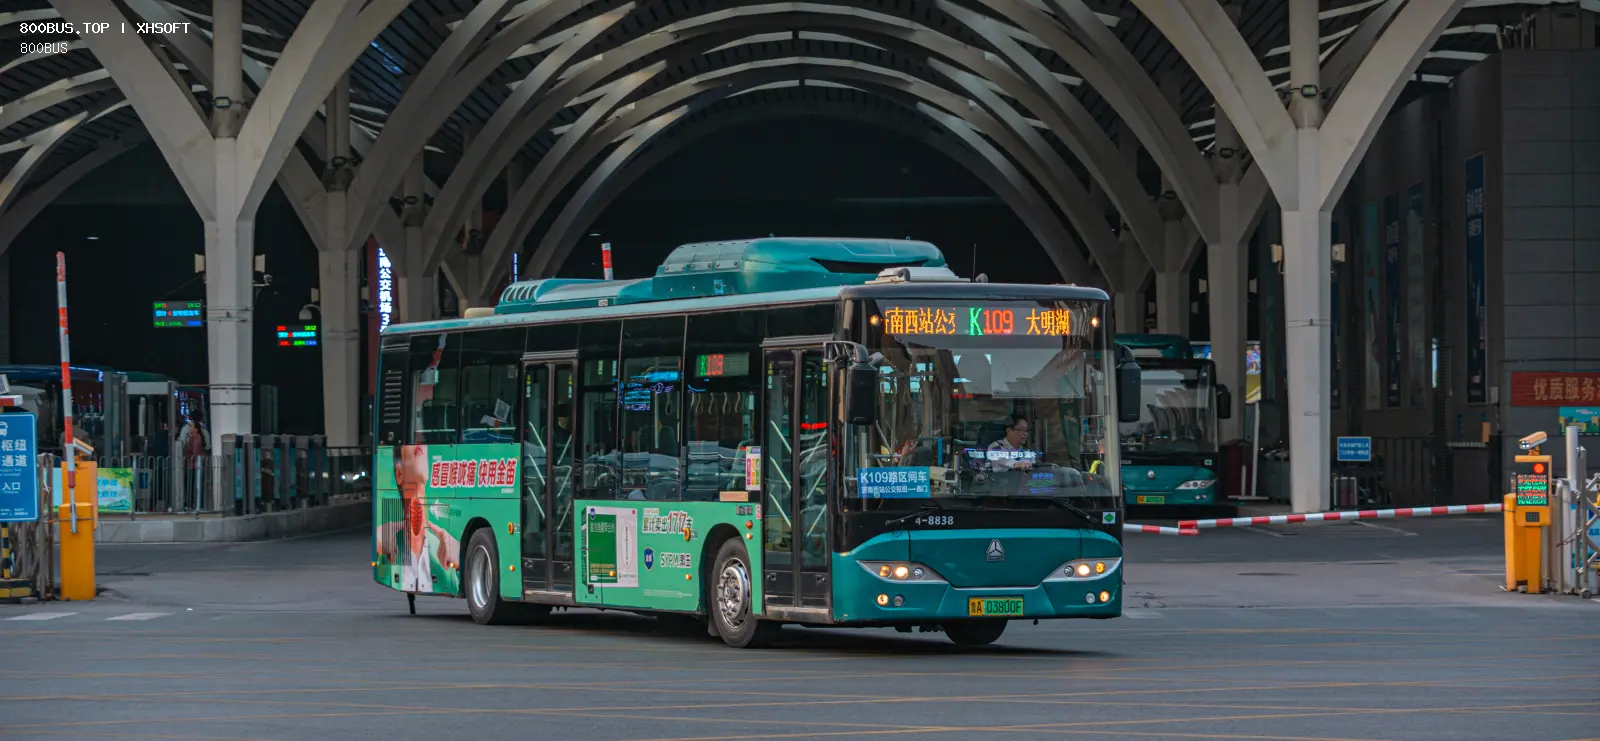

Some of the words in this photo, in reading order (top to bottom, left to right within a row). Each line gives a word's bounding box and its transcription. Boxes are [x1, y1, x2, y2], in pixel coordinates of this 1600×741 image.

[969, 307, 1015, 336] K109
[1025, 308, 1071, 336] 大明湖
[700, 353, 725, 376] K109
[1533, 377, 1600, 401] 优质服务
[479, 459, 517, 487] 快用金笛
[860, 471, 927, 484] K109路区间车
[914, 515, 954, 526] 4-8838
[986, 600, 1022, 613] 03800F
